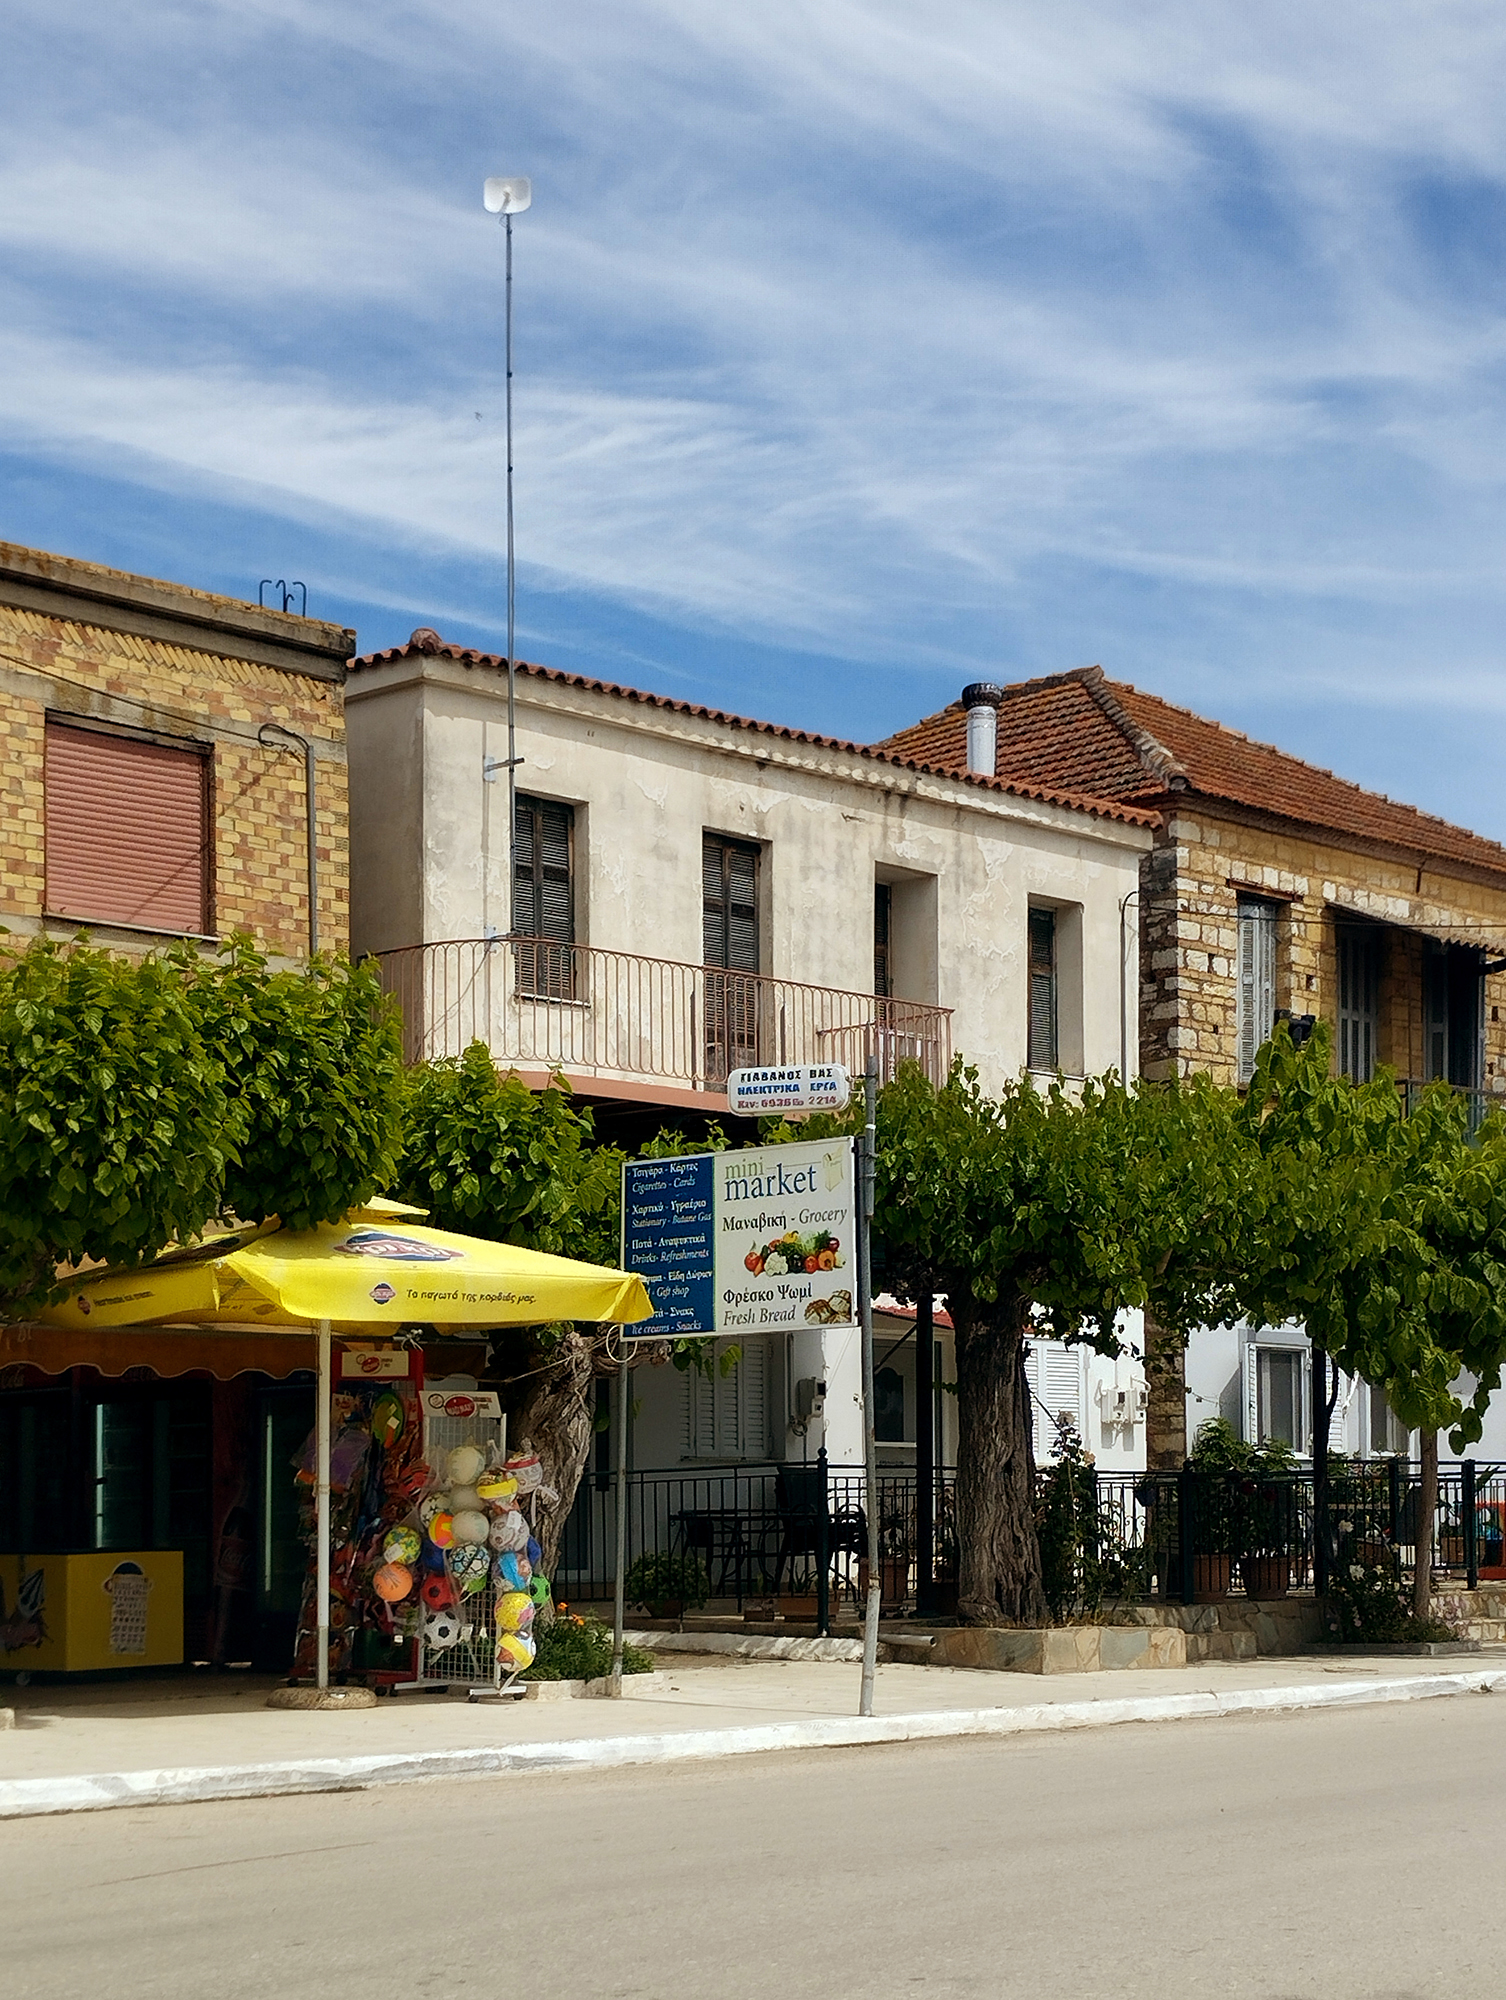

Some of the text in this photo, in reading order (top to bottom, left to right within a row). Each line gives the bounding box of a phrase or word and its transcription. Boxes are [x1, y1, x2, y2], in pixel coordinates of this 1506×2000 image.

[737, 1081, 838, 1096] ΗΛΕΚΤΡΙΚΑ ΕΡΓΑ
[631, 1162, 698, 1179] Τσιγάρα Κάρτες
[725, 1156, 765, 1180] mini
[674, 1174, 696, 1188] Cards
[724, 1163, 818, 1202] market
[671, 1198, 707, 1214] Υγραέριο
[697, 1211, 712, 1222] Gas
[722, 1207, 848, 1233] Μαναβική Grocery
[632, 1233, 706, 1250] Ποτά Αναψυκτικά
[660, 1248, 710, 1264] Refreshments
[668, 1270, 685, 1283] Είδη
[686, 1268, 714, 1281] Δώρων
[406, 1288, 419, 1299] Το
[421, 1289, 459, 1302] παγωτό
[461, 1292, 477, 1303] της
[672, 1285, 690, 1298] shop
[723, 1282, 813, 1307] Φρέσκο Ψωμί
[669, 1306, 695, 1317] Σνακς
[723, 1305, 796, 1326] Fresh Bread
[643, 1323, 670, 1333] creams
[675, 1319, 702, 1332] Snacks
